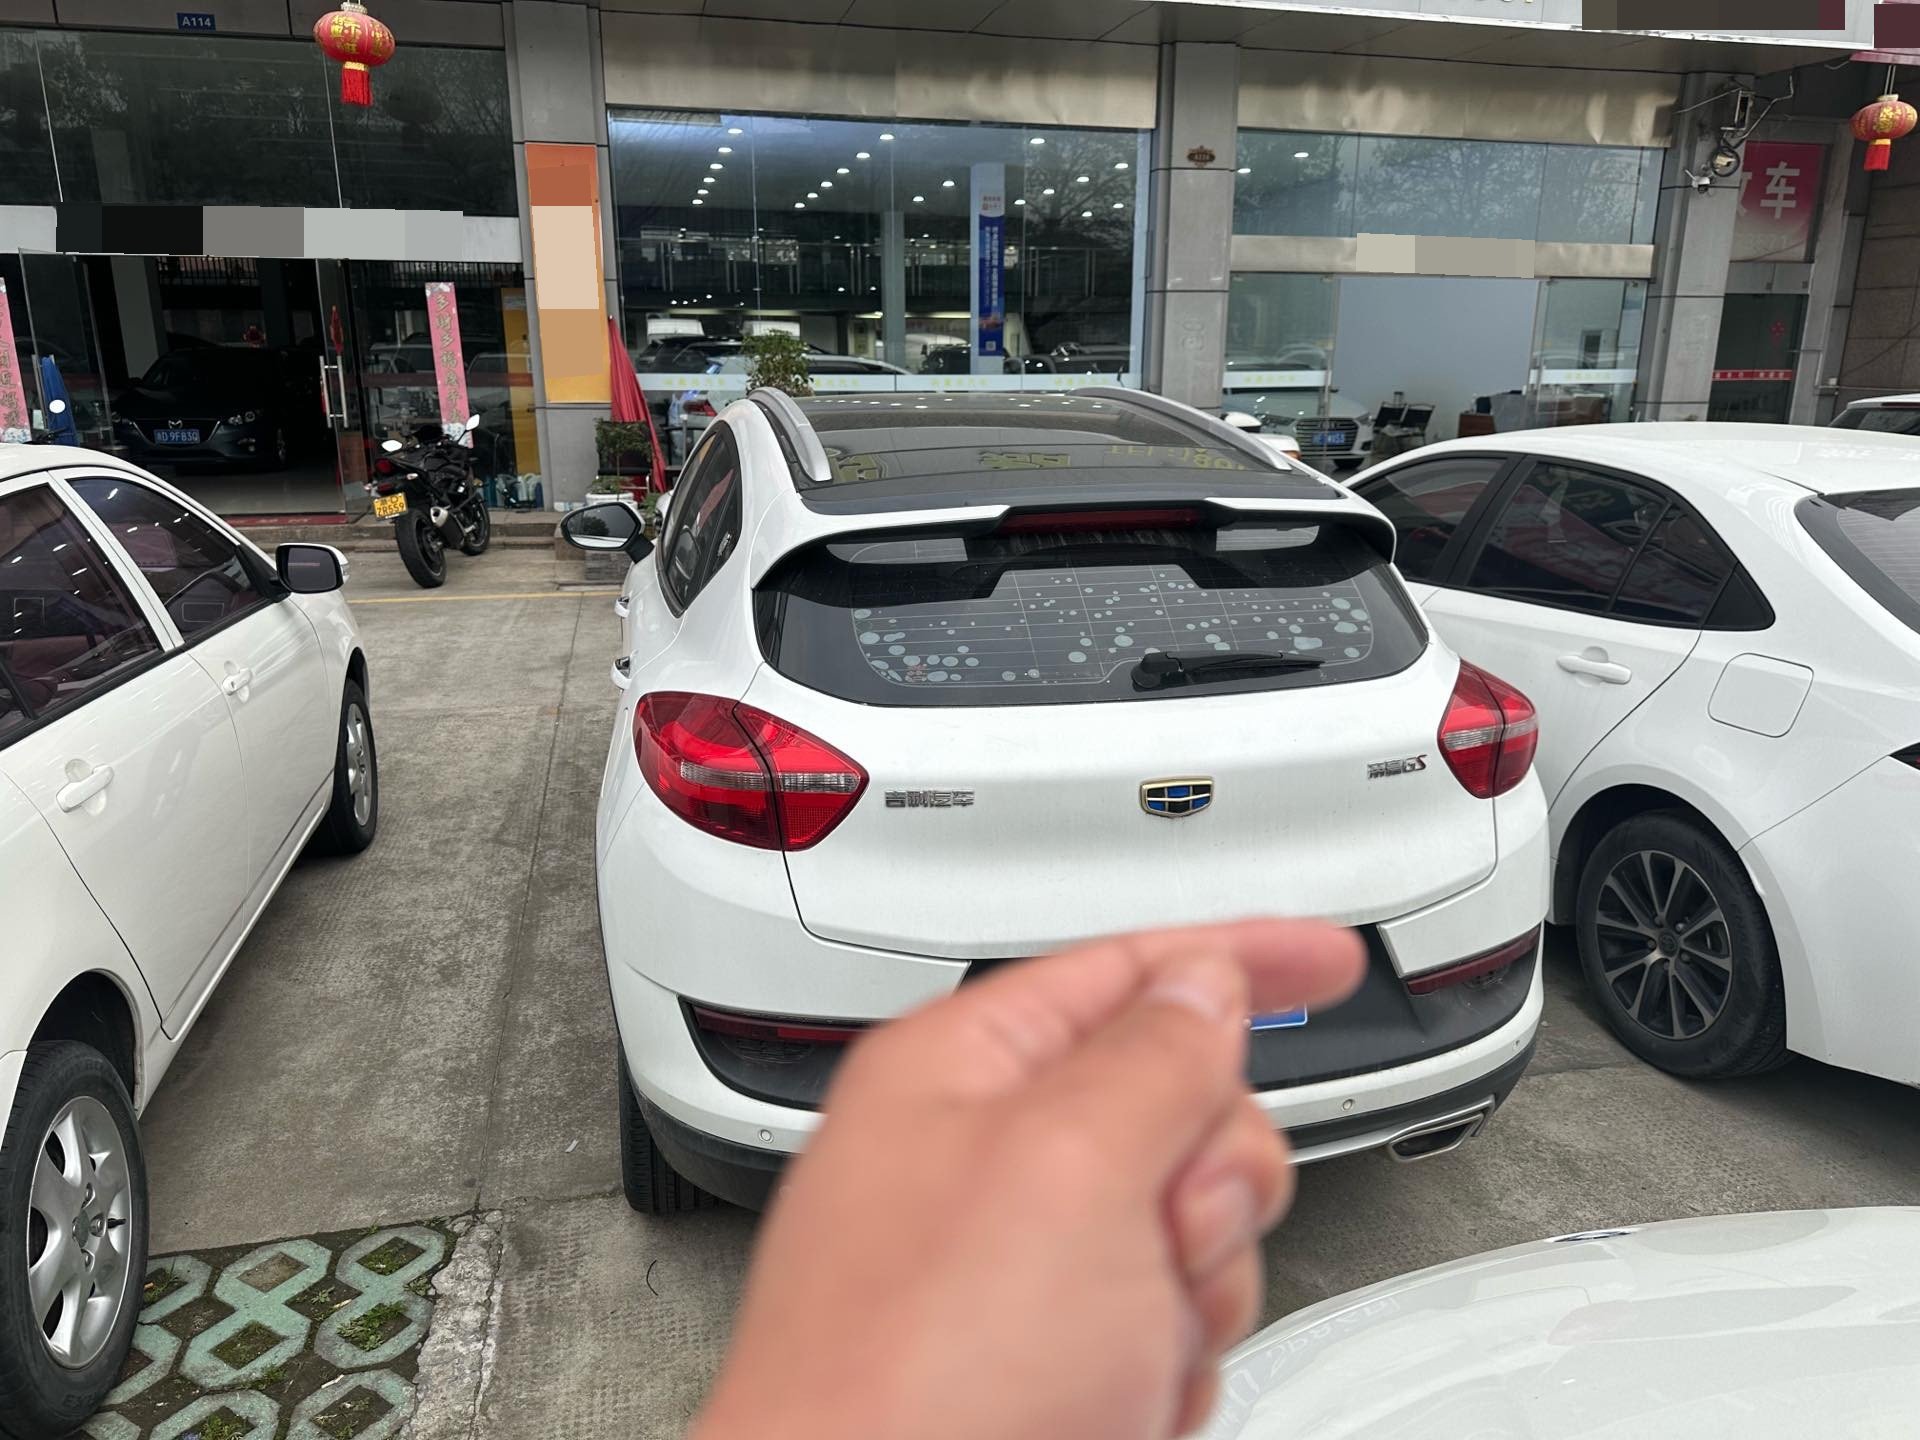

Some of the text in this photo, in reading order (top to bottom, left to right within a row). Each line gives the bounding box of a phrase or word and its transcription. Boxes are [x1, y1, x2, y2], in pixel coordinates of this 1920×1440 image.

[182, 16, 212, 27] A114
[884, 790, 975, 808] 吉利汽车
